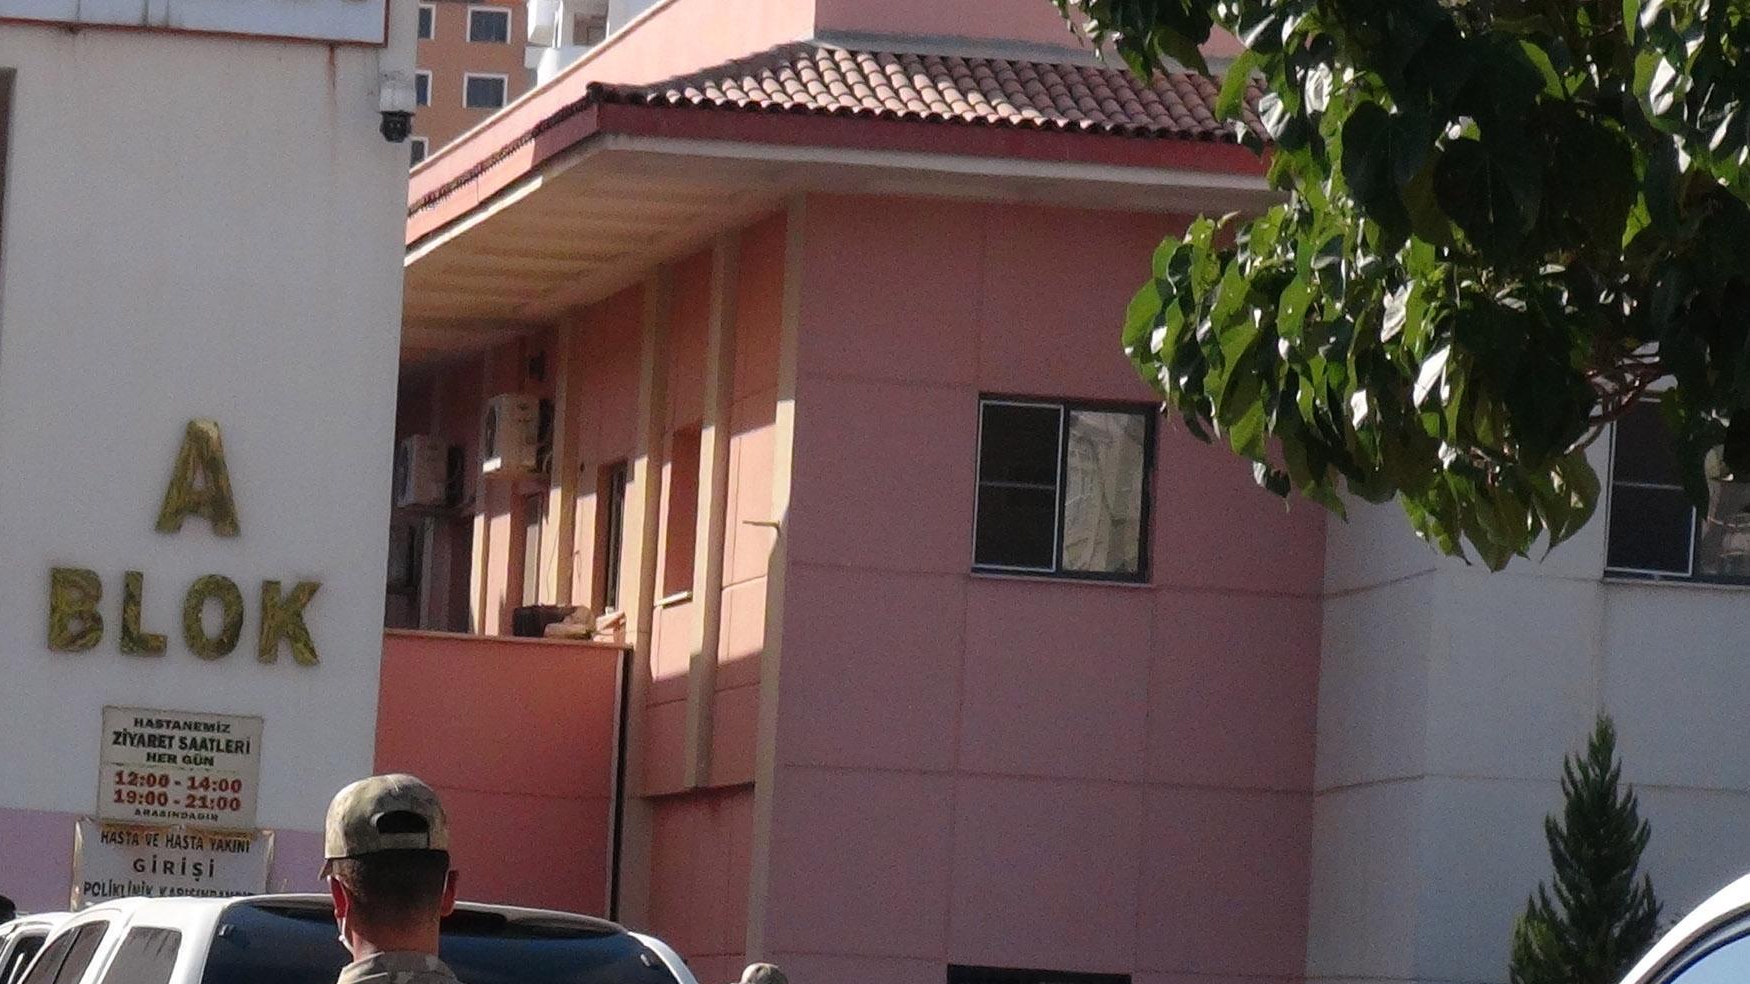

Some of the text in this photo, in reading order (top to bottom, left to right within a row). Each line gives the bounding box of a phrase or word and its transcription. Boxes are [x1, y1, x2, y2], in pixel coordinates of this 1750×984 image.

[155, 418, 240, 537] A
[48, 567, 322, 665] BLOK
[134, 718, 230, 734] HASTANEMİZ
[112, 728, 250, 755] ZİYARET SAATLERİ
[146, 752, 177, 764] HER
[115, 770, 170, 788] 12:00
[187, 776, 242, 794] 14:00
[113, 789, 169, 807] 19:00
[185, 795, 241, 812] 21:00
[101, 831, 250, 853] HASTA VE HASTA YAKINI
[133, 855, 214, 882] GİRİŞİ
